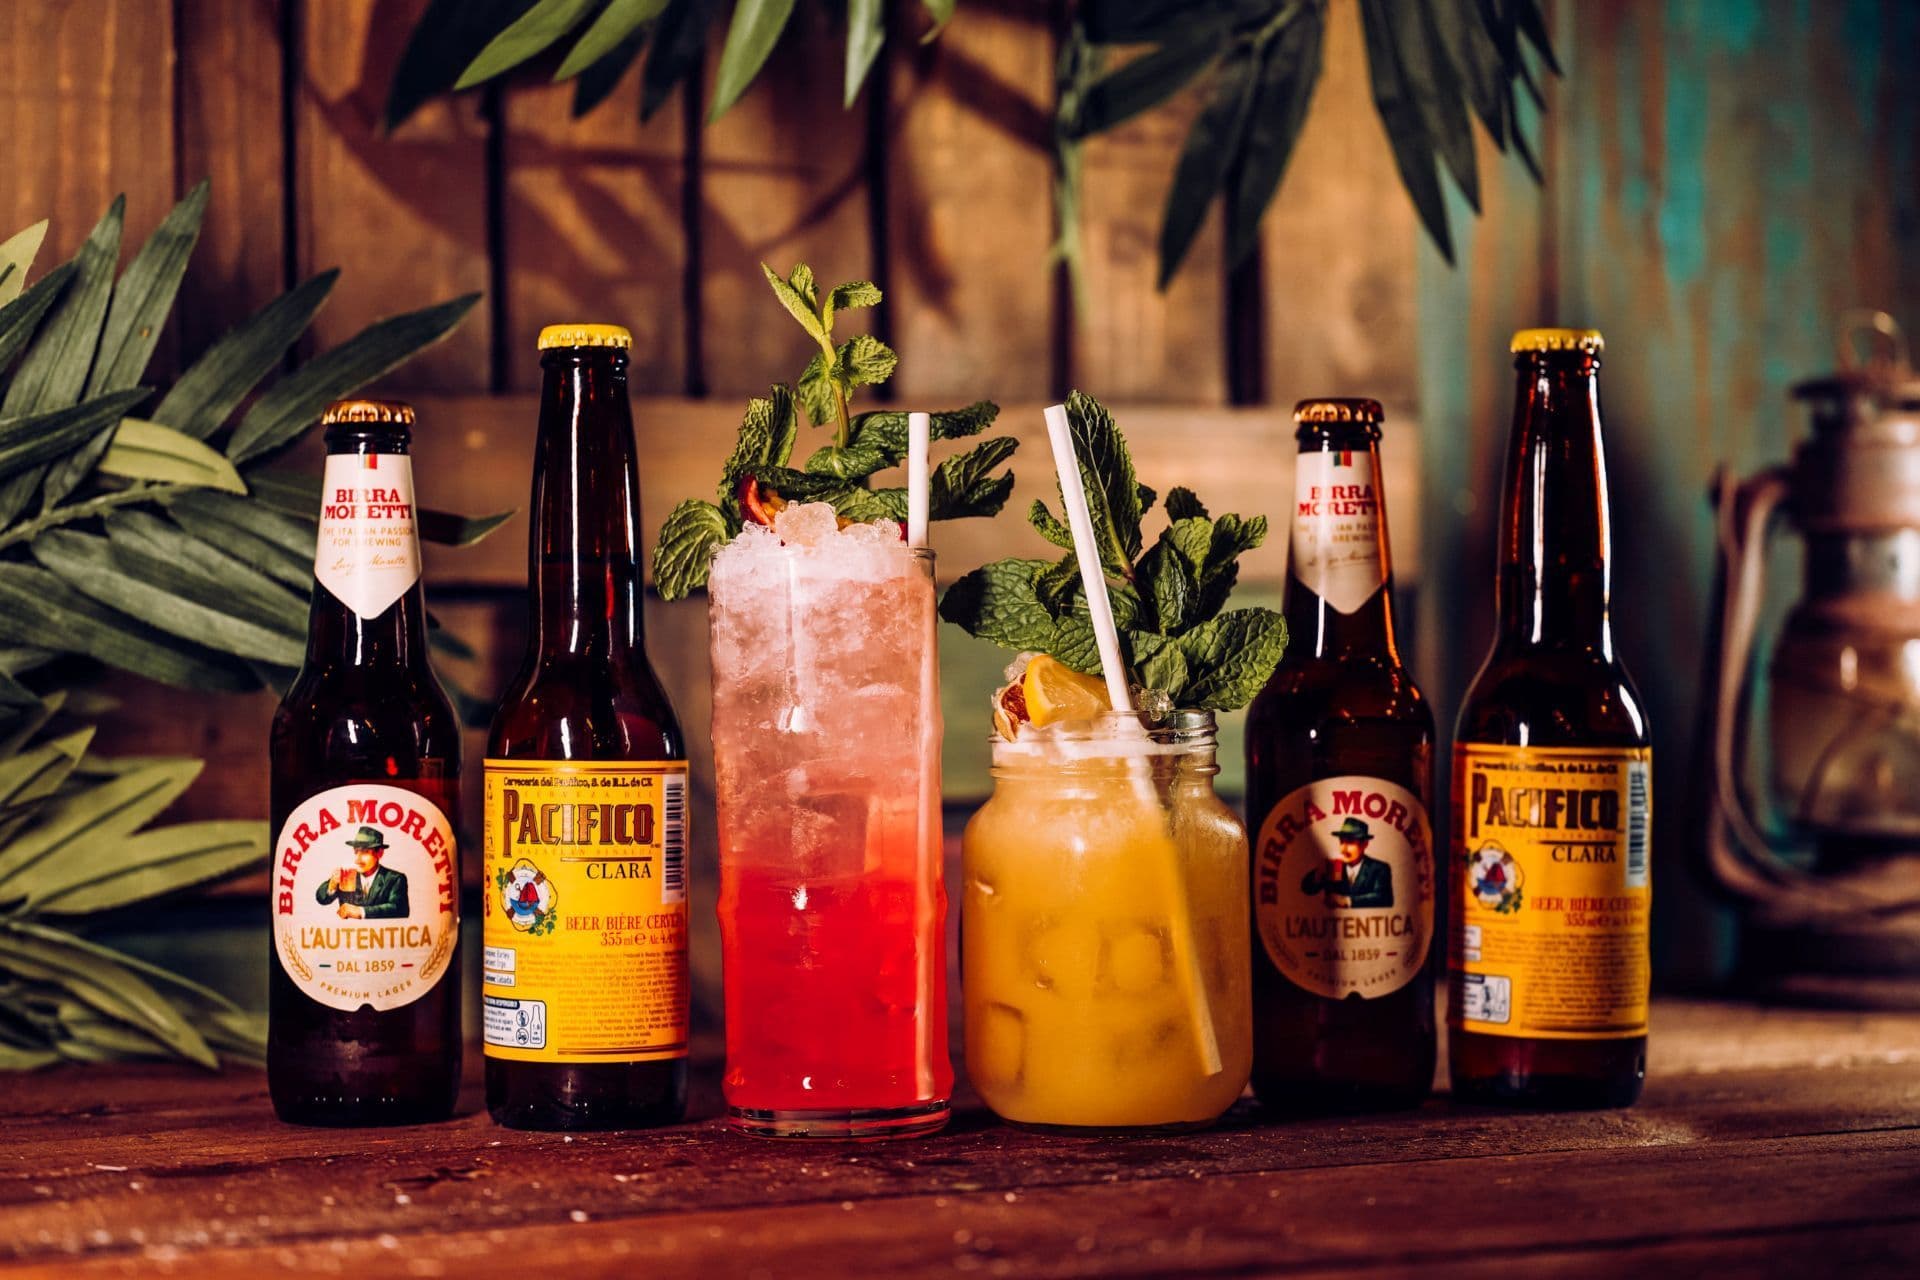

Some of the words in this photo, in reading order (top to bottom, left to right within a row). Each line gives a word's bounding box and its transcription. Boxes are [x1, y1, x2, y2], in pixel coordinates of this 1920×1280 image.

[1311, 485, 1374, 500] BRRA
[1470, 772, 1621, 839] PACIFICO
[503, 789, 655, 859] PACIFICO
[279, 807, 342, 916] BIRRA
[346, 799, 454, 914] MORETTI
[1260, 800, 1326, 906] BIRRA
[1331, 790, 1430, 902] MORETTI
[1551, 845, 1617, 864] CLARA
[586, 862, 652, 880] CLARA
[1285, 915, 1414, 939] L'AUTENTICA
[300, 925, 432, 951] L'AUTENTICA
[600, 932, 623, 946] 355
[1351, 948, 1381, 961] 1859
[336, 961, 361, 973] DAL
[364, 959, 396, 973] 1859
[319, 980, 371, 999] PREMIUM
[377, 980, 413, 998] LAGER
